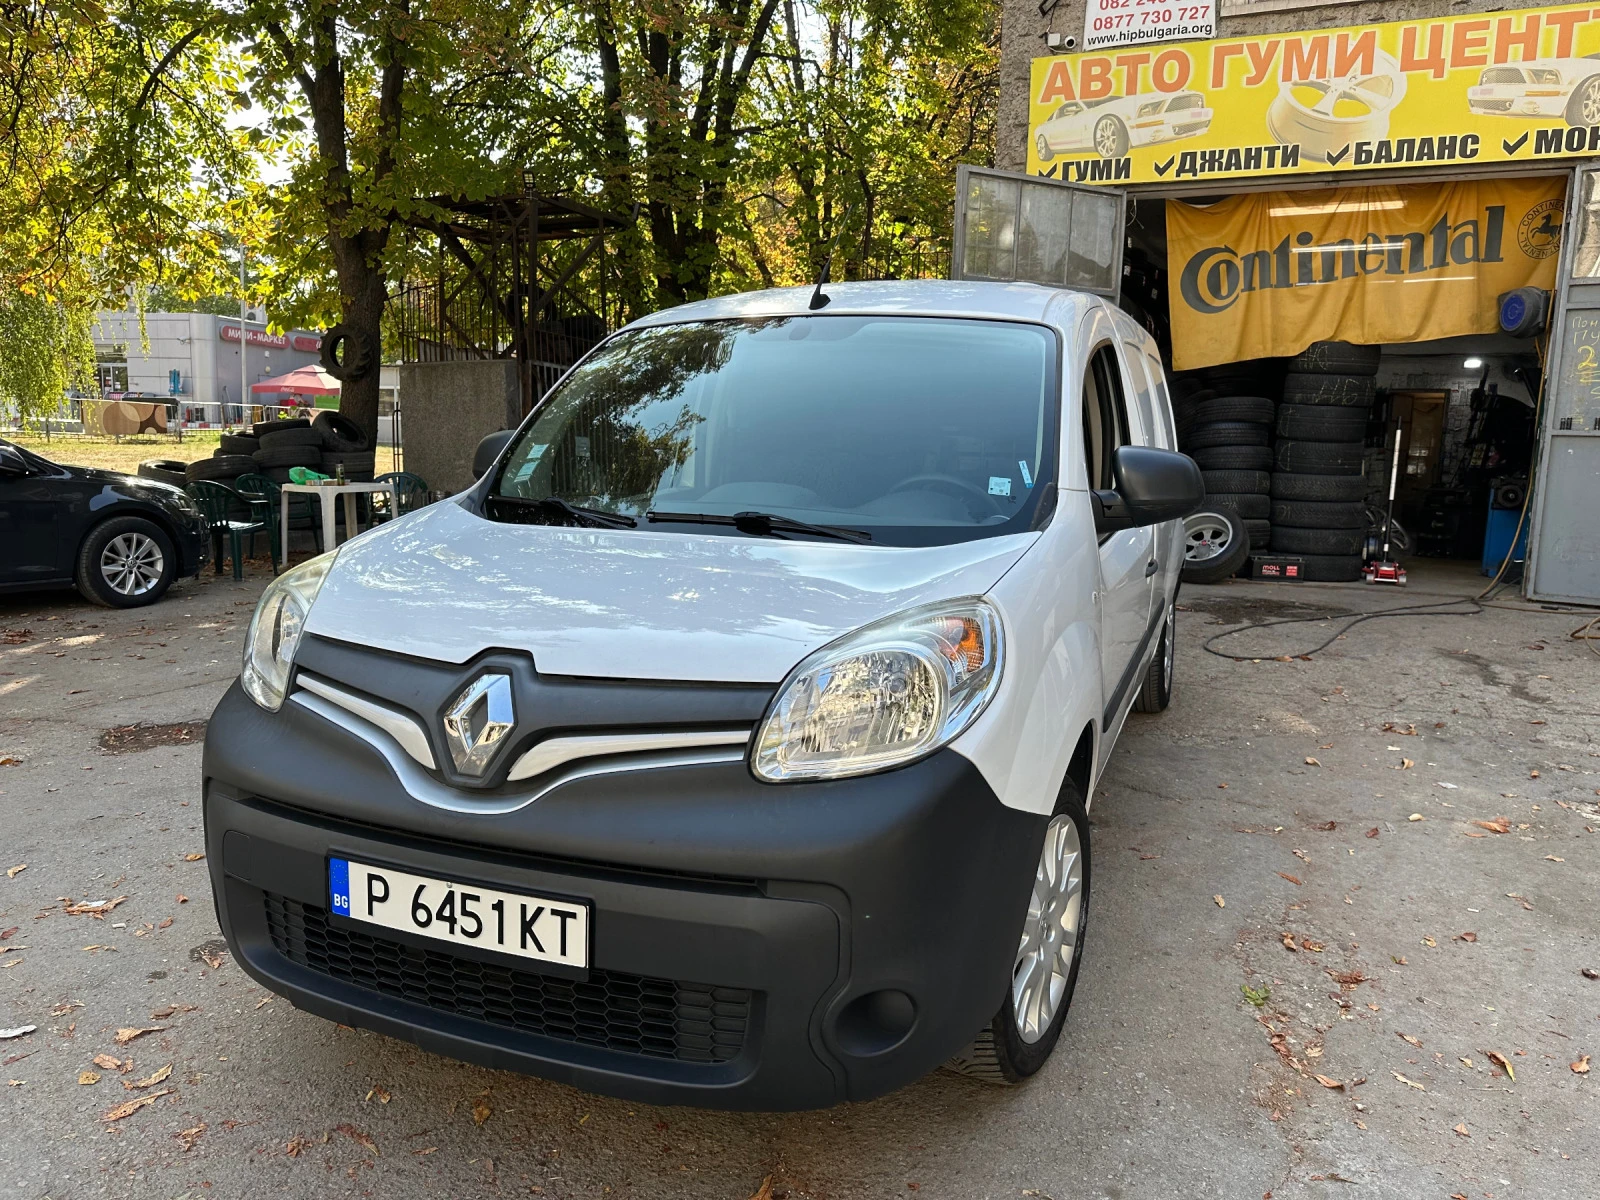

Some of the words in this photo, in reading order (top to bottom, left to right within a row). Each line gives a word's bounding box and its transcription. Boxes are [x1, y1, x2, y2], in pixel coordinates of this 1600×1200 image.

[1087, 24, 1213, 46] www.hipbulgaria.org
[1093, 13, 1135, 31] 0877
[1141, 9, 1172, 25] 730
[1178, 5, 1210, 21] 727
[1040, 49, 1191, 104] АВТО
[1211, 30, 1376, 89] ГУМИ
[1400, 9, 1600, 78] ЦЕНТ
[1061, 157, 1131, 182] ГУМИ
[1175, 144, 1299, 178] ДЖАНТИ
[1353, 134, 1480, 165] БАЛАНС
[1180, 205, 1505, 314] Continental
[228, 328, 286, 345] МИИ-МАРКЕТ
[333, 893, 348, 908] BG
[366, 872, 390, 917] P
[411, 884, 505, 946] 6451
[520, 903, 578, 957] KT
